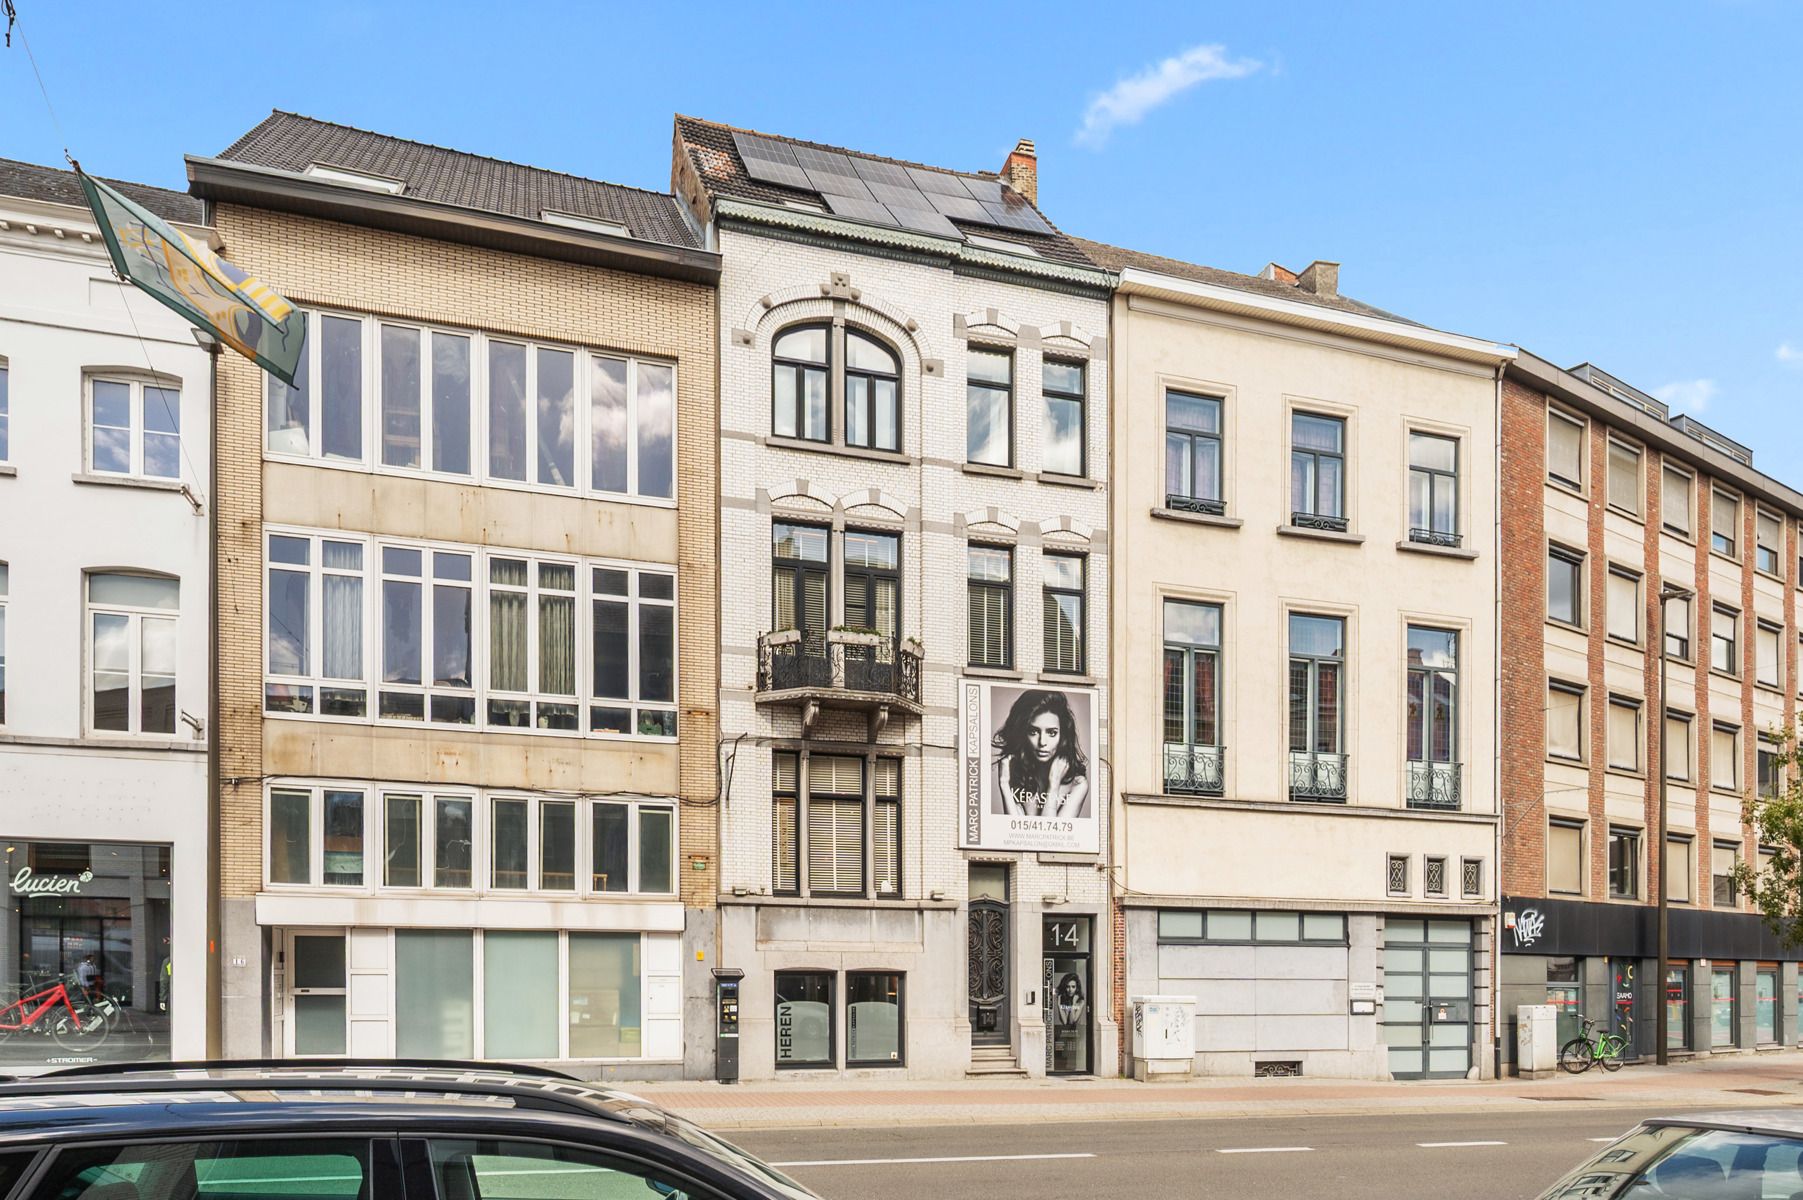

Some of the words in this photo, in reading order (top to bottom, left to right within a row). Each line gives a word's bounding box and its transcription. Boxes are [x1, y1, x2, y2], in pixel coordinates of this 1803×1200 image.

[969, 687, 978, 755] KAPSALONS
[969, 759, 979, 807] PATRICK
[1010, 787, 1072, 806] KÉRASSE
[969, 808, 979, 842] MARC
[1010, 820, 1073, 832] 015/41.74.79
[9, 866, 81, 895] lucien
[1051, 923, 1079, 947] 14
[780, 1006, 792, 1059] HEREN
[981, 1012, 994, 1025] 14
